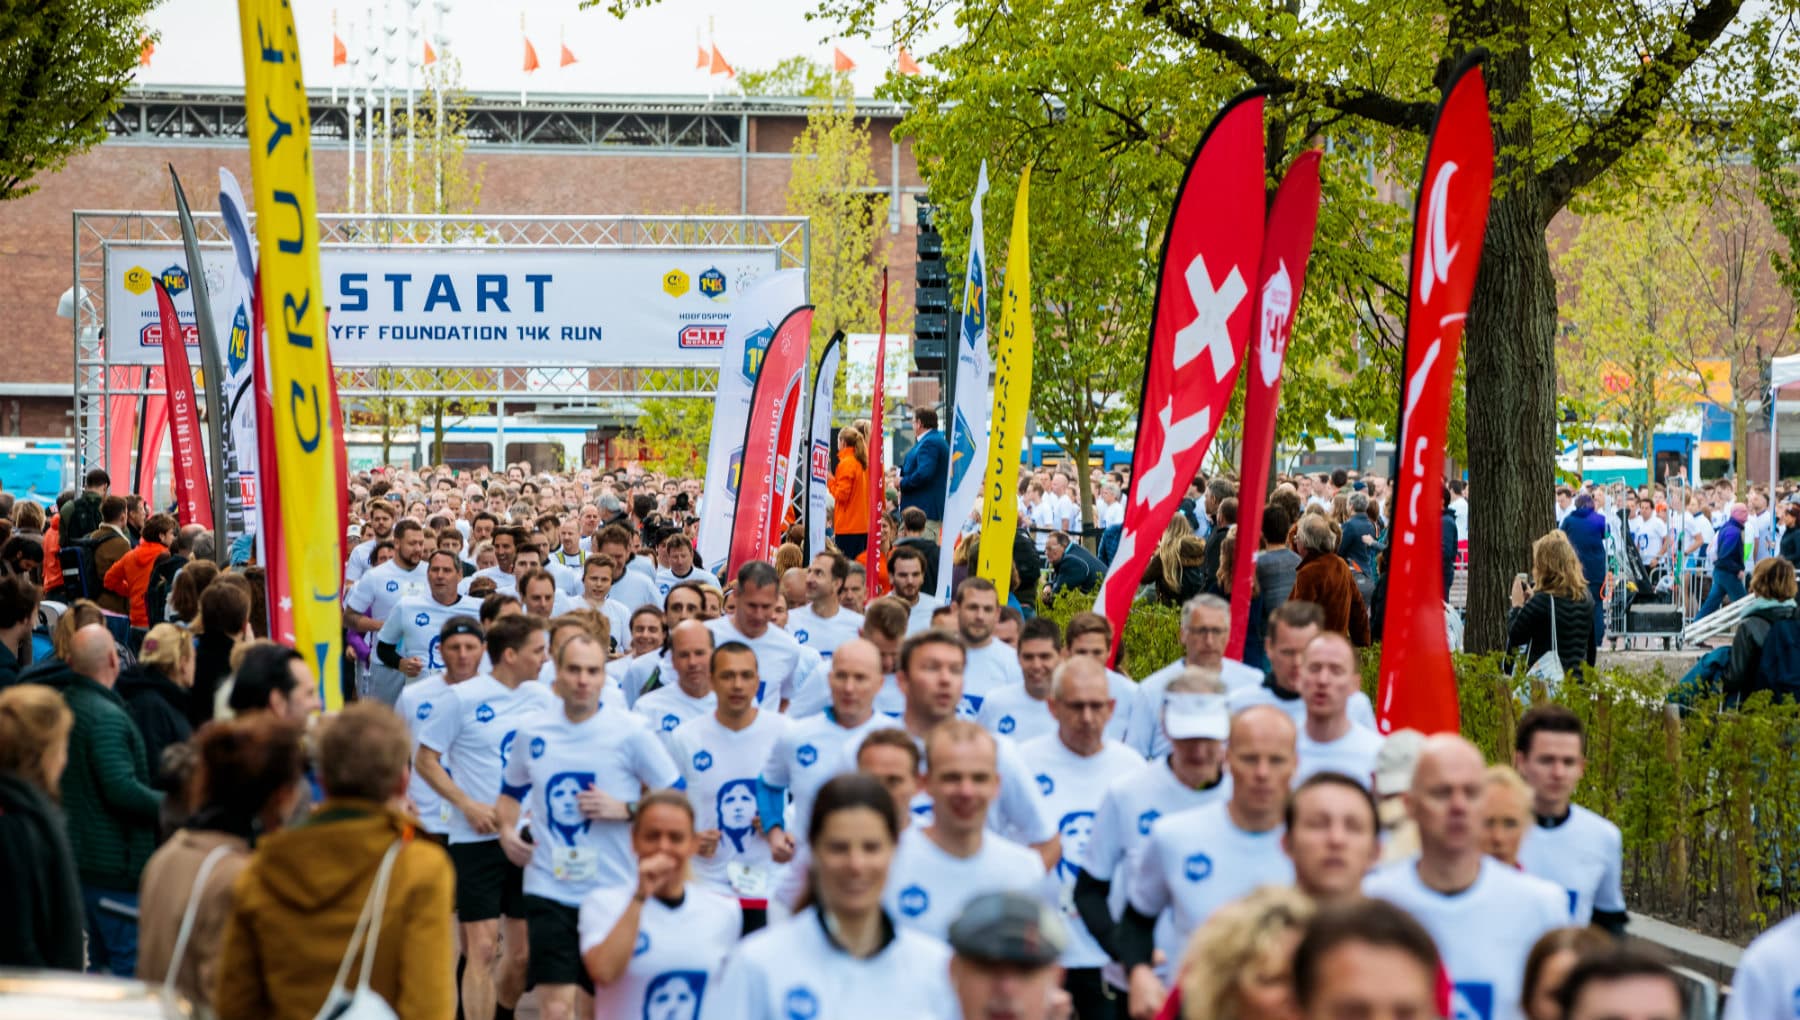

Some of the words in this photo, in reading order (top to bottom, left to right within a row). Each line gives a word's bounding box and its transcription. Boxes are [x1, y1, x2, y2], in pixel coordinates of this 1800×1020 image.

[339, 273, 553, 313] START
[679, 312, 732, 320] HOOFDSPON
[378, 325, 508, 342] FOUNDATION
[516, 326, 551, 342] 14K
[560, 326, 602, 342] RUN
[175, 388, 194, 468] CLINICS
